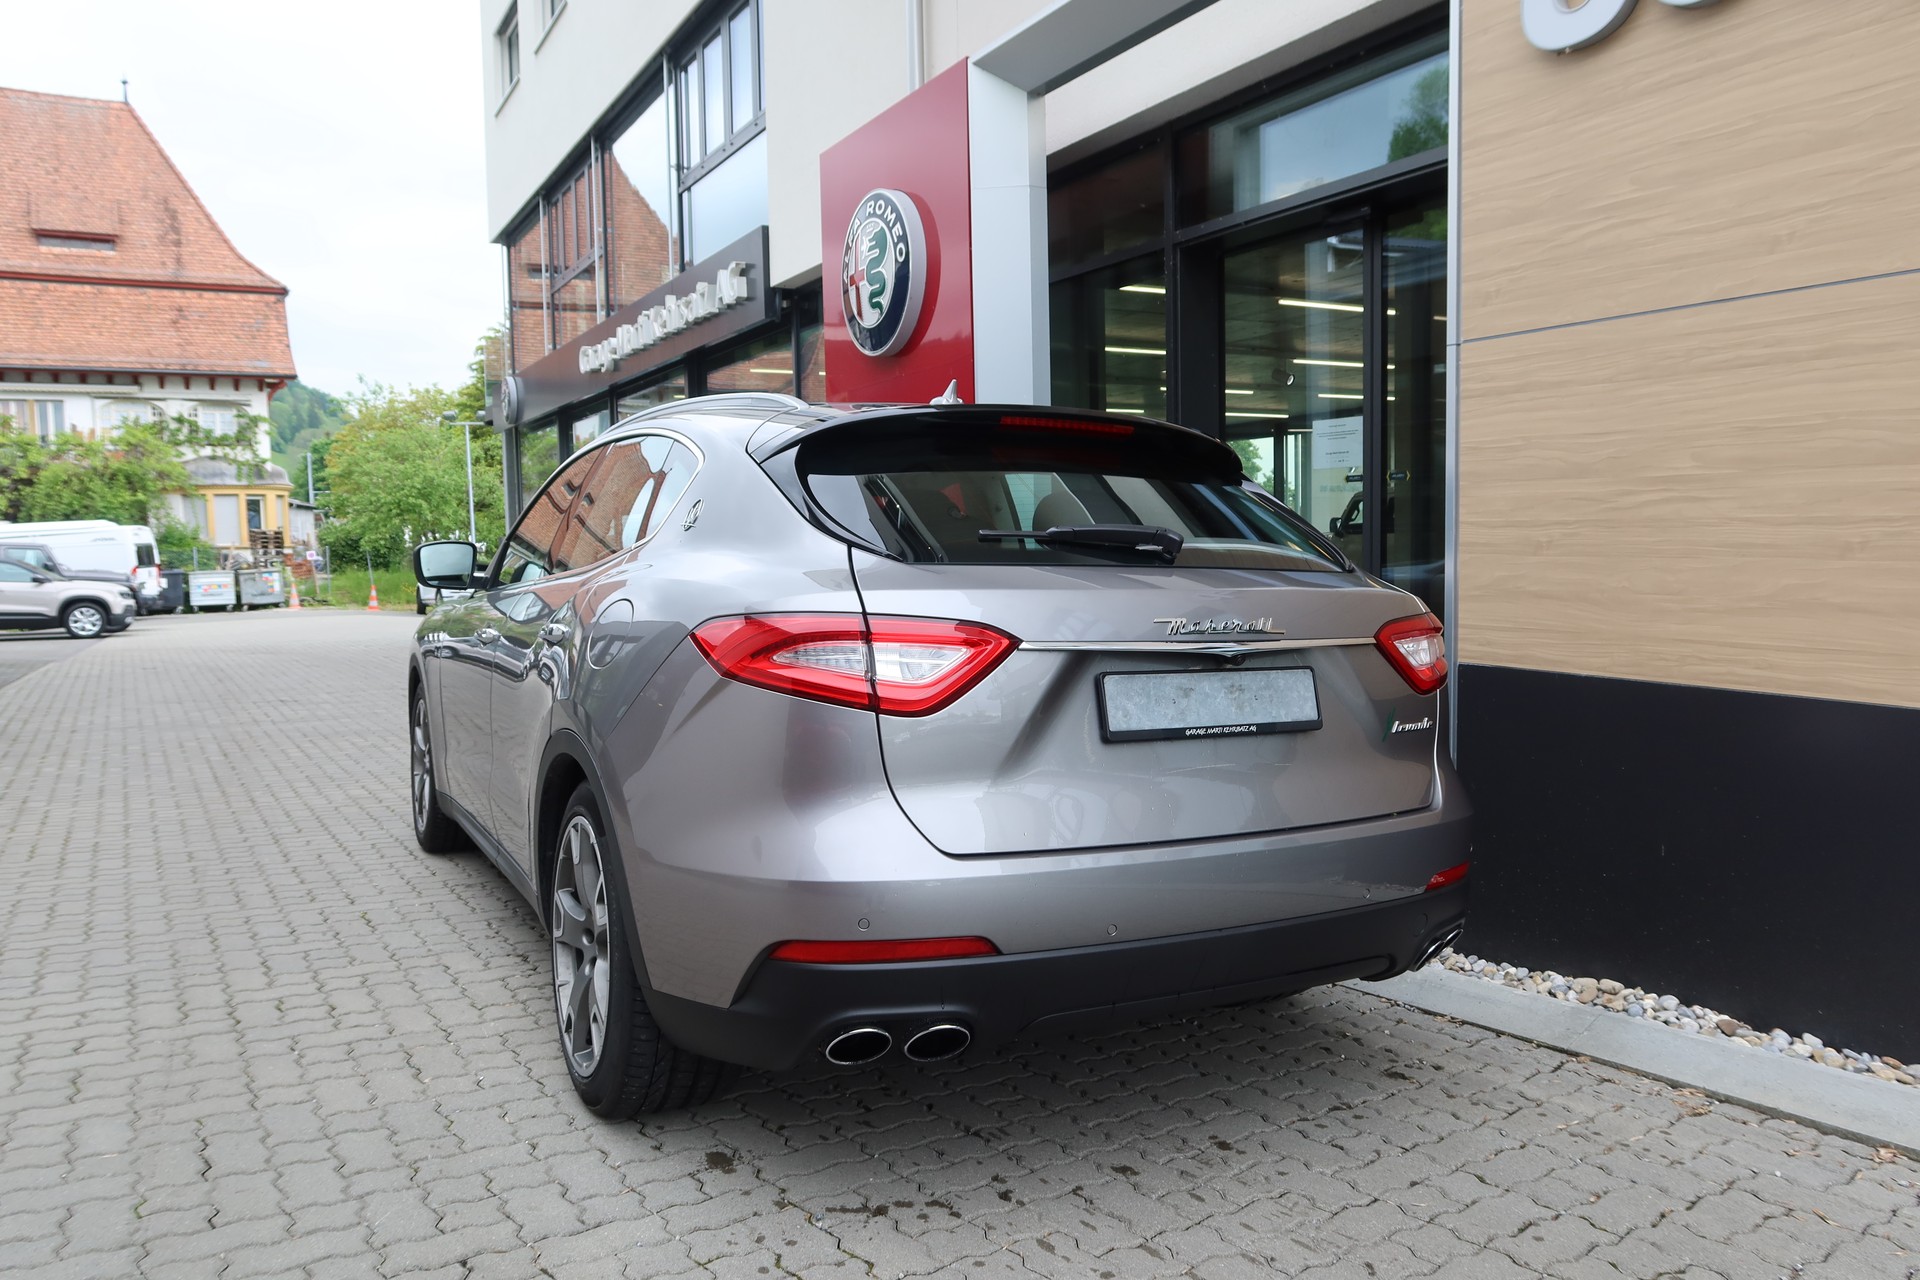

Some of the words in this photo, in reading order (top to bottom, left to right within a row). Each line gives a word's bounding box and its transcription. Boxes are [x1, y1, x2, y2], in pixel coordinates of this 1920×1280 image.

[843, 217, 861, 284] ALFA
[866, 199, 906, 263] ROMEO
[715, 261, 748, 309] AG
[1153, 617, 1285, 636] Maserati
[1185, 728, 1207, 736] GARAGE
[1207, 726, 1223, 734] MARTI
[1249, 724, 1257, 732] AG
